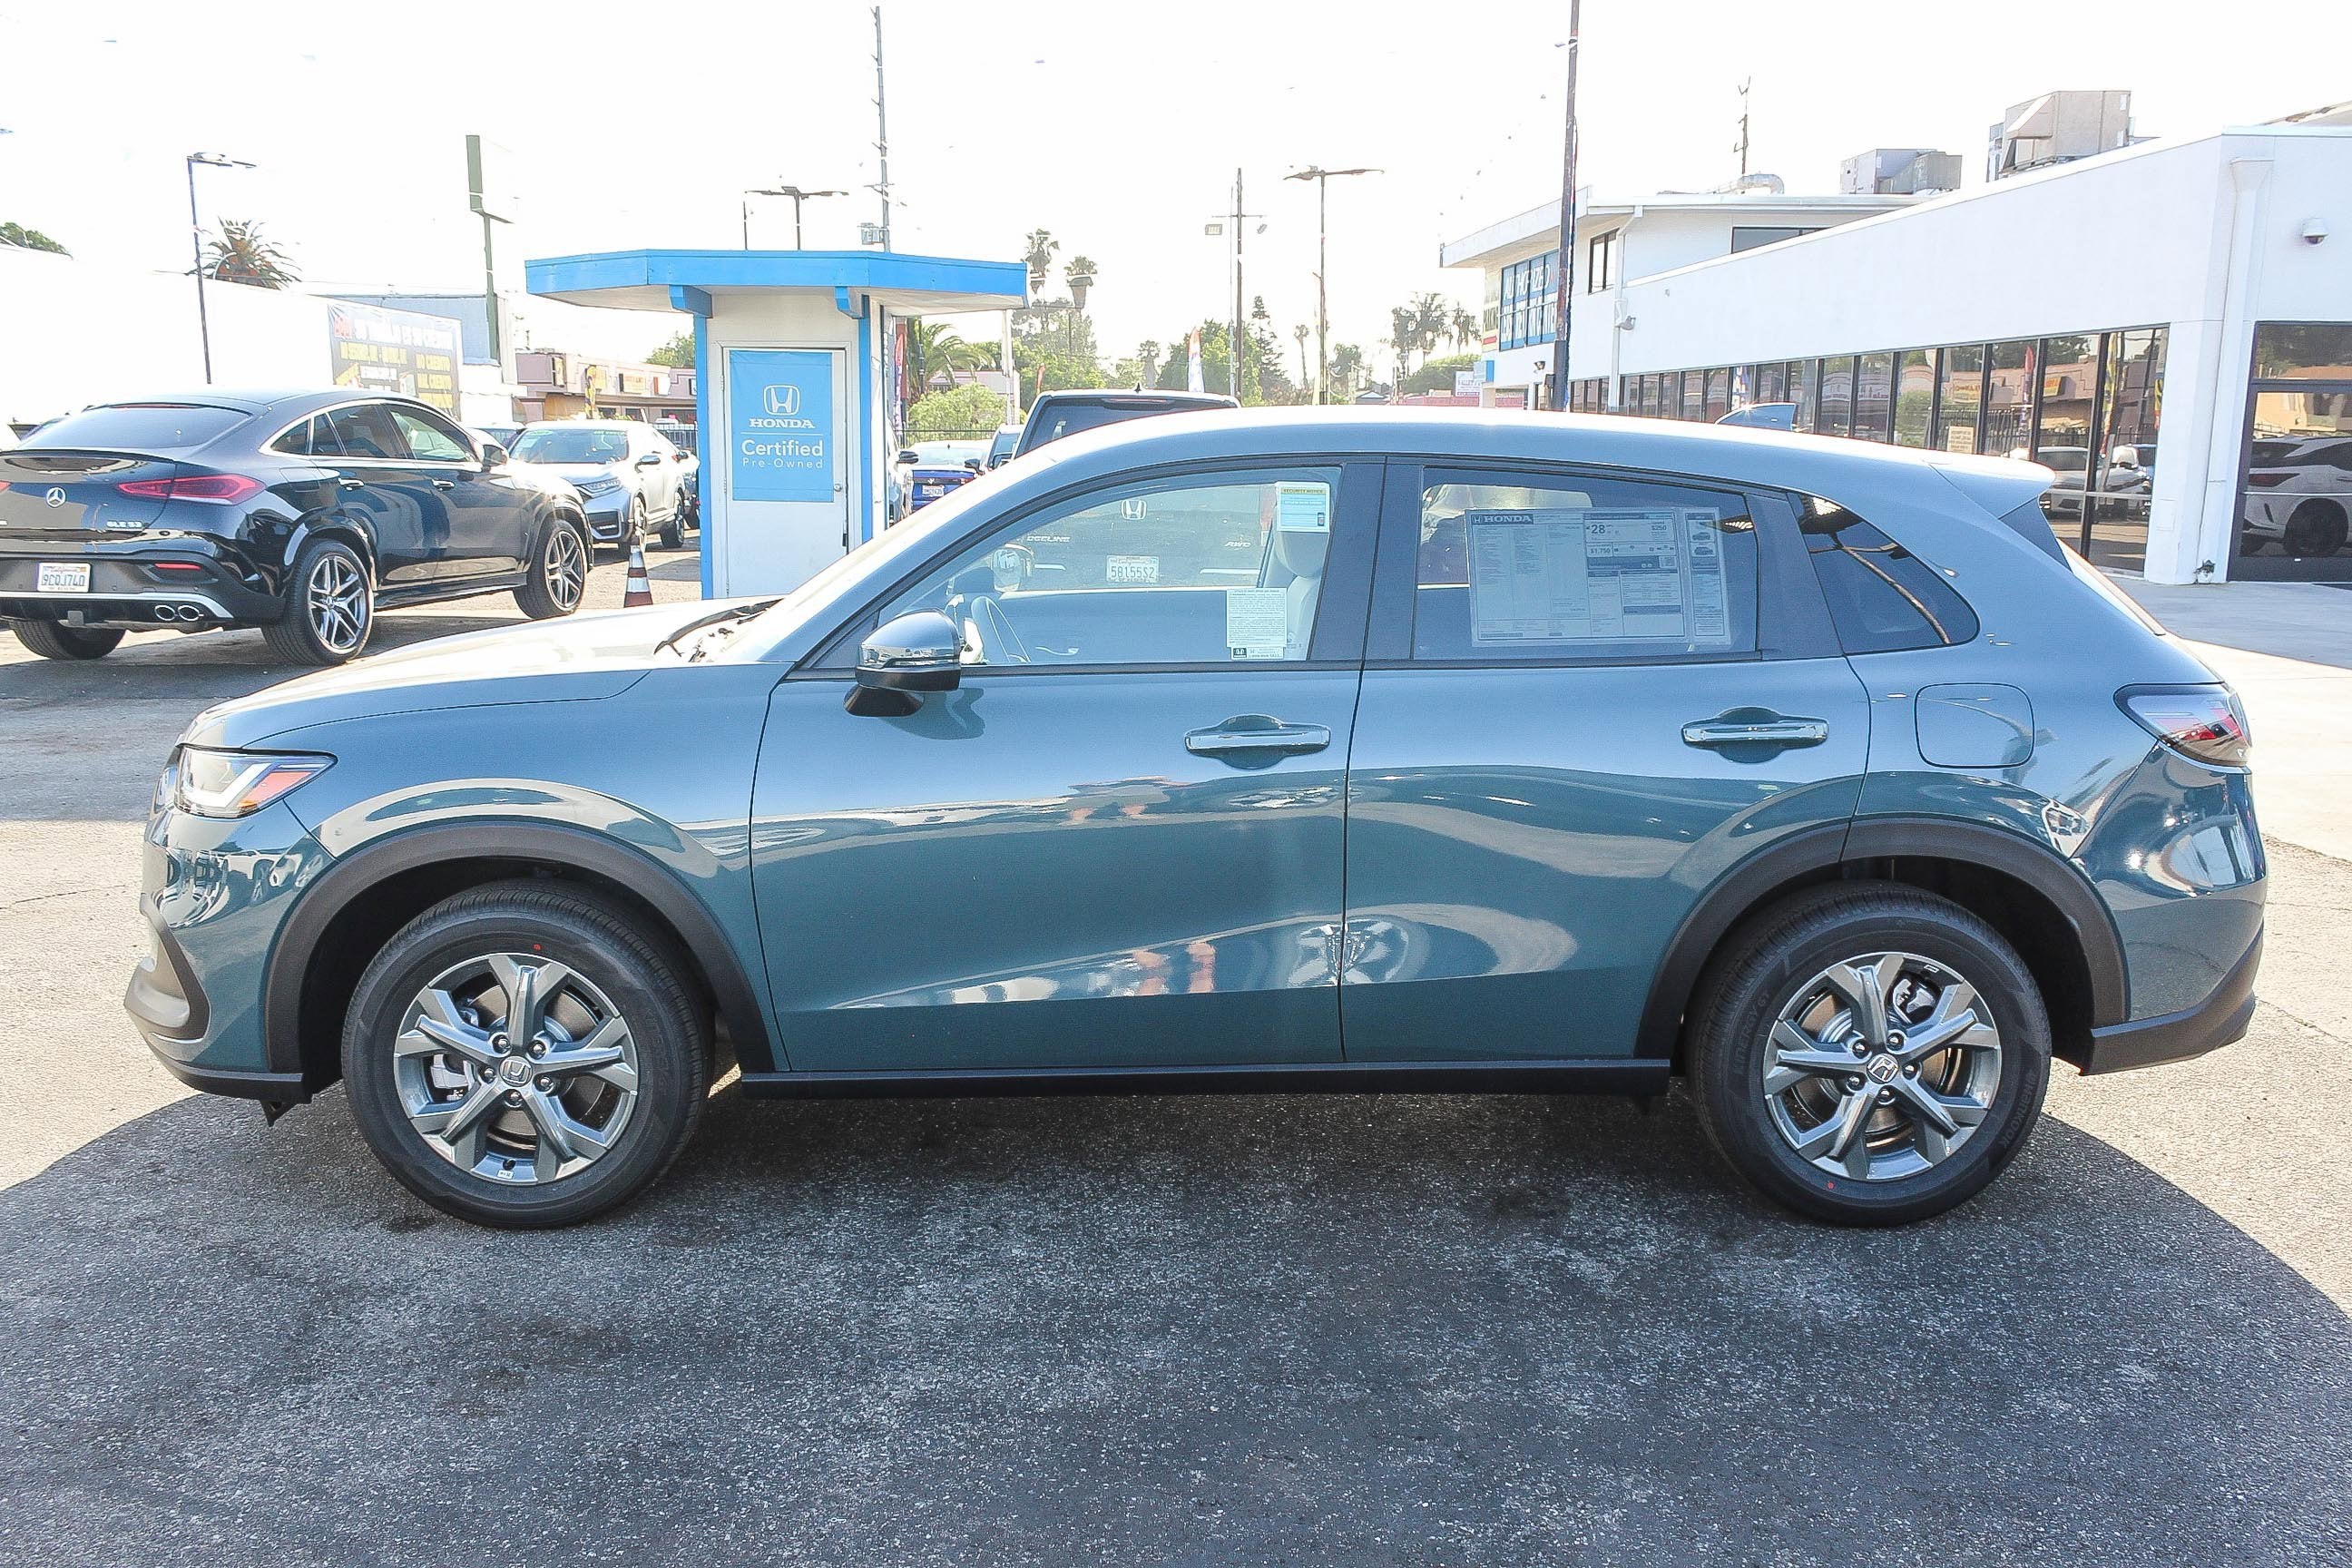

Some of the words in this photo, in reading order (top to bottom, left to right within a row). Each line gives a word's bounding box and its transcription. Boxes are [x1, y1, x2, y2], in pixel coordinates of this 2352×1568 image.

[750, 418, 816, 428] HONDA
[741, 438, 823, 456] Certified
[742, 457, 823, 468] Pre-Owned
[1484, 515, 1533, 524] HONDA
[1591, 524, 1605, 534] 28
